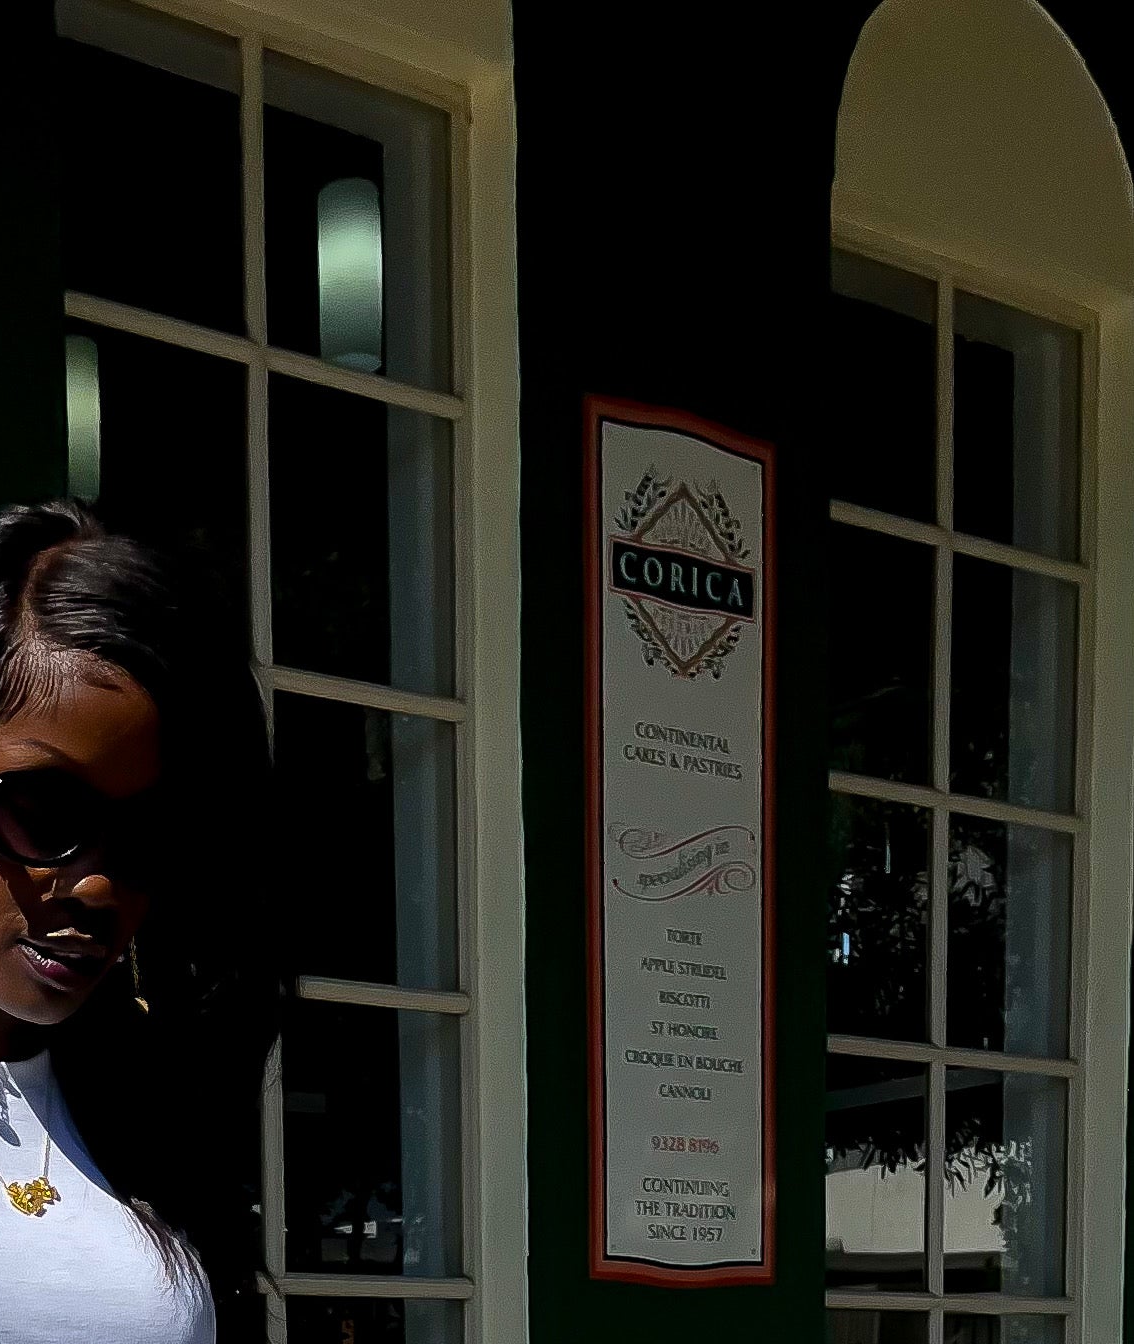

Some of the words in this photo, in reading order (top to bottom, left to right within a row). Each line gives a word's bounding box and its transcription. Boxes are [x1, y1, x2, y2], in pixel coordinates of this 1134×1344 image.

[619, 551, 744, 607] CORICA
[634, 720, 730, 754] CONTINENTAL
[622, 744, 666, 767] CAKES
[683, 754, 742, 779] PASTRIES
[641, 957, 675, 975] APPLE
[677, 960, 727, 980] STRUDEL
[658, 990, 711, 1009] BISCOTTI
[651, 1021, 665, 1036] ST
[624, 1049, 675, 1068] CROQUE
[677, 1054, 694, 1069] EN
[695, 1056, 743, 1073] BOUCHE
[658, 1083, 711, 1101] CANNOLI
[651, 1135, 686, 1152] 9328
[642, 1177, 730, 1198] CONTINUING
[634, 1200, 661, 1217] THE
[664, 1201, 737, 1221] TRADITION
[646, 1223, 687, 1241] SINCE
[692, 1226, 723, 1242] 1957
